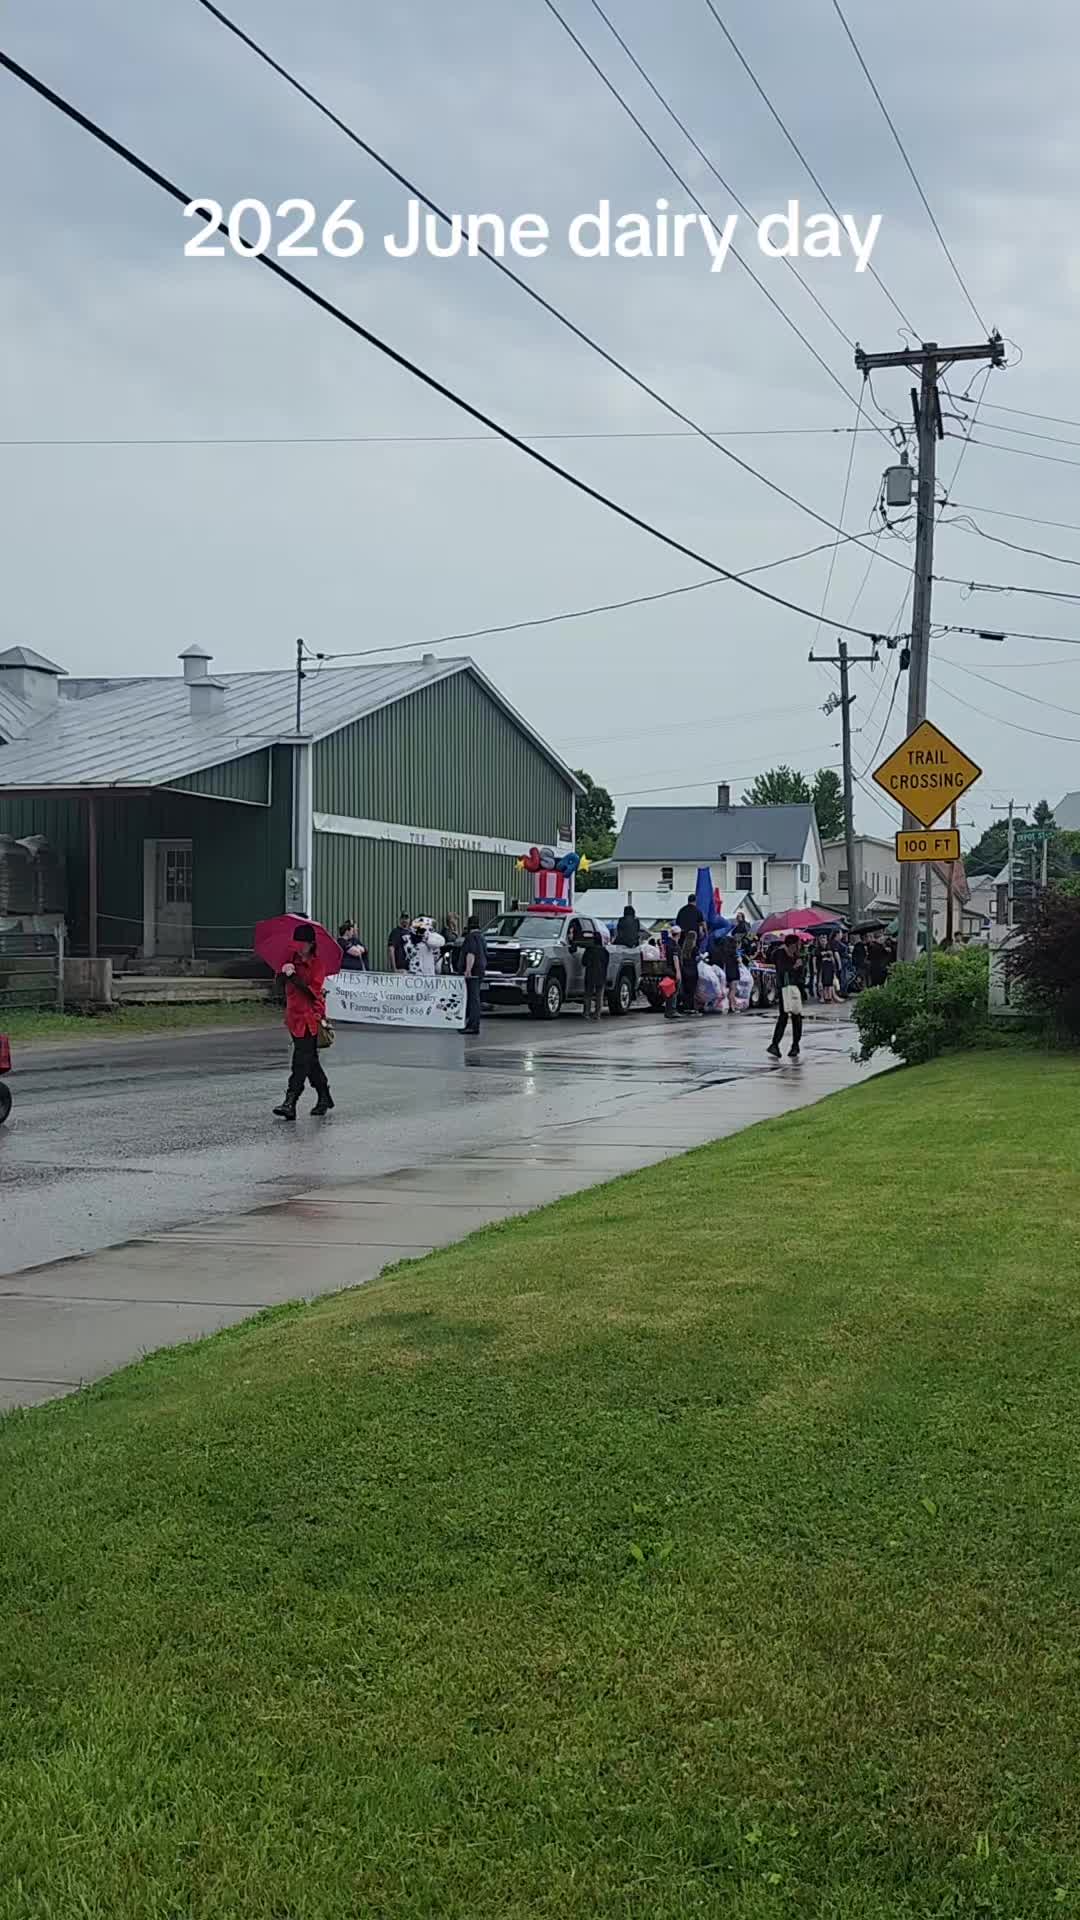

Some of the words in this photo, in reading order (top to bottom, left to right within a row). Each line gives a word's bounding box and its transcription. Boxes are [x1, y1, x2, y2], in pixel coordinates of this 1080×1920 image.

[907, 750, 949, 766] TRAIL
[890, 772, 964, 790] CROSSING
[409, 832, 425, 843] THE
[904, 839, 927, 853] 100
[934, 839, 951, 851] FT
[520, 847, 579, 878] USA
[335, 973, 361, 985] PLES
[365, 974, 400, 988] TRUST
[404, 977, 463, 990] COMPANY
[380, 990, 414, 1001] Vermont
[349, 1001, 380, 1013] Farmers
[382, 1004, 403, 1015] Since
